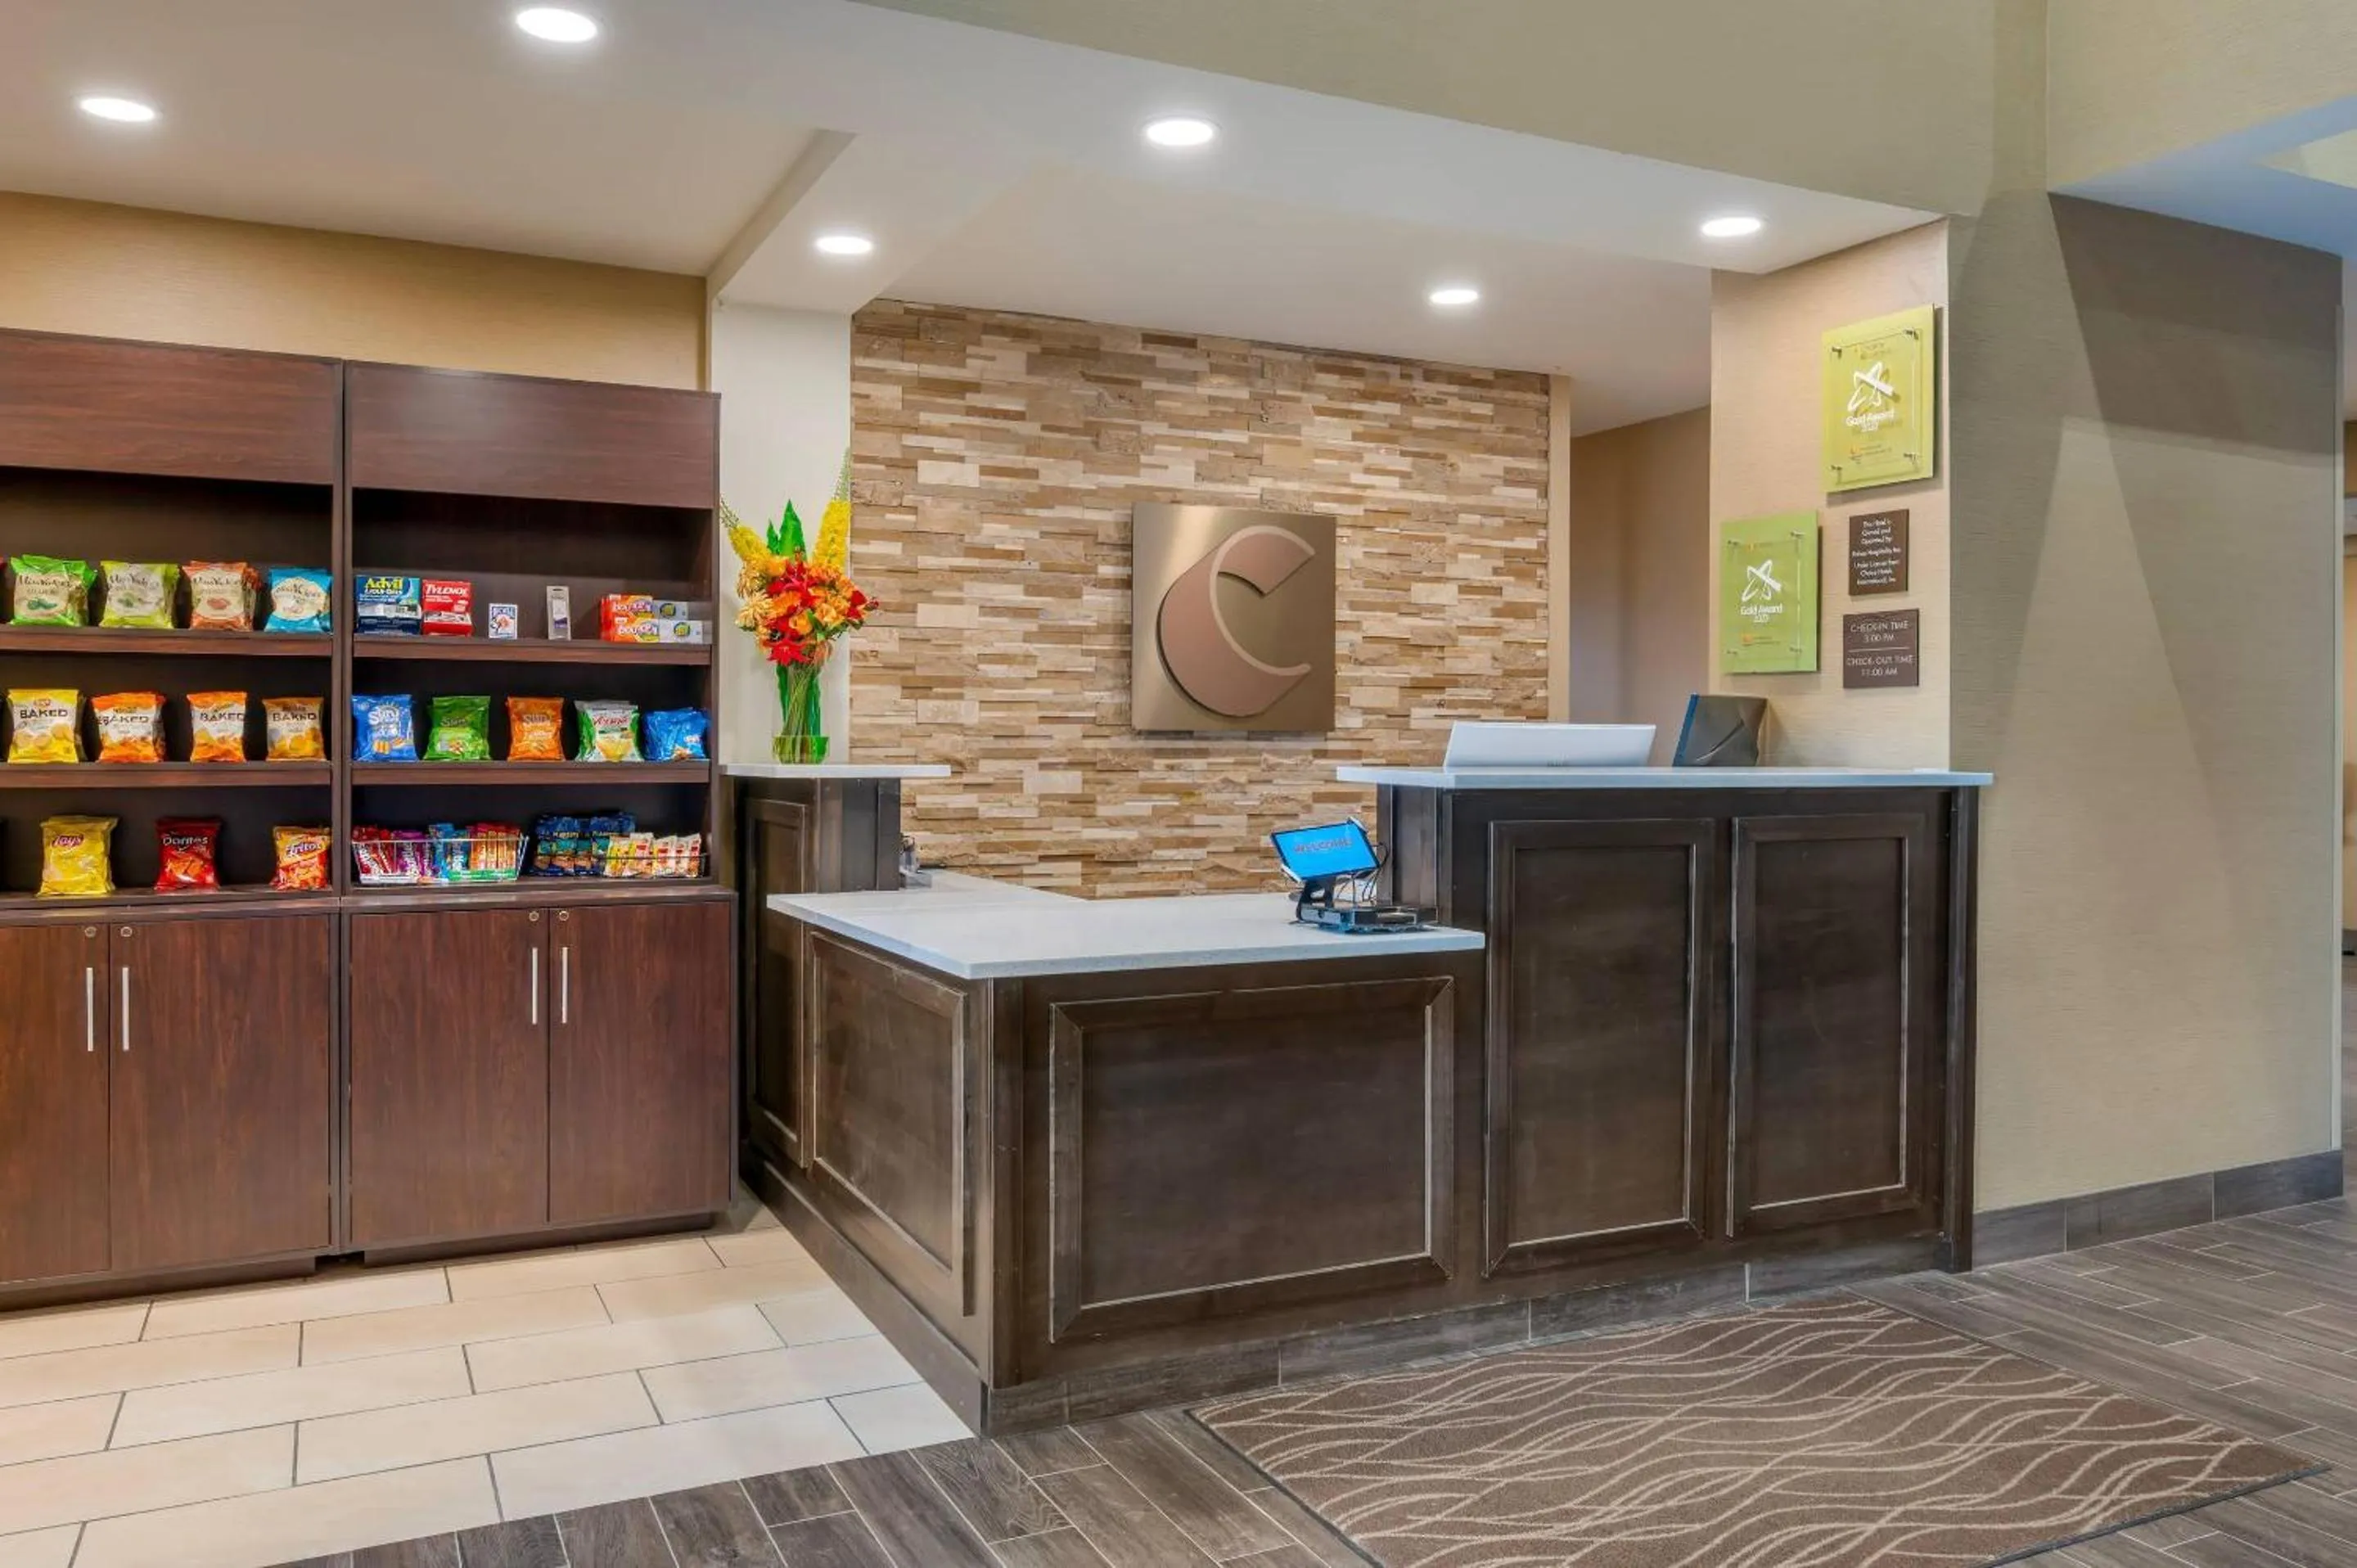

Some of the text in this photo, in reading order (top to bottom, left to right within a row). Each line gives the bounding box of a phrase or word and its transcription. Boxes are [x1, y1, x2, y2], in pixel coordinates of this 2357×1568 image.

[364, 577, 403, 590] Advil
[425, 583, 470, 597] TYLENOL
[20, 707, 69, 719] BAKED
[200, 711, 245, 723] BAKED
[273, 712, 318, 722] BAKED
[162, 834, 209, 846] Doritos
